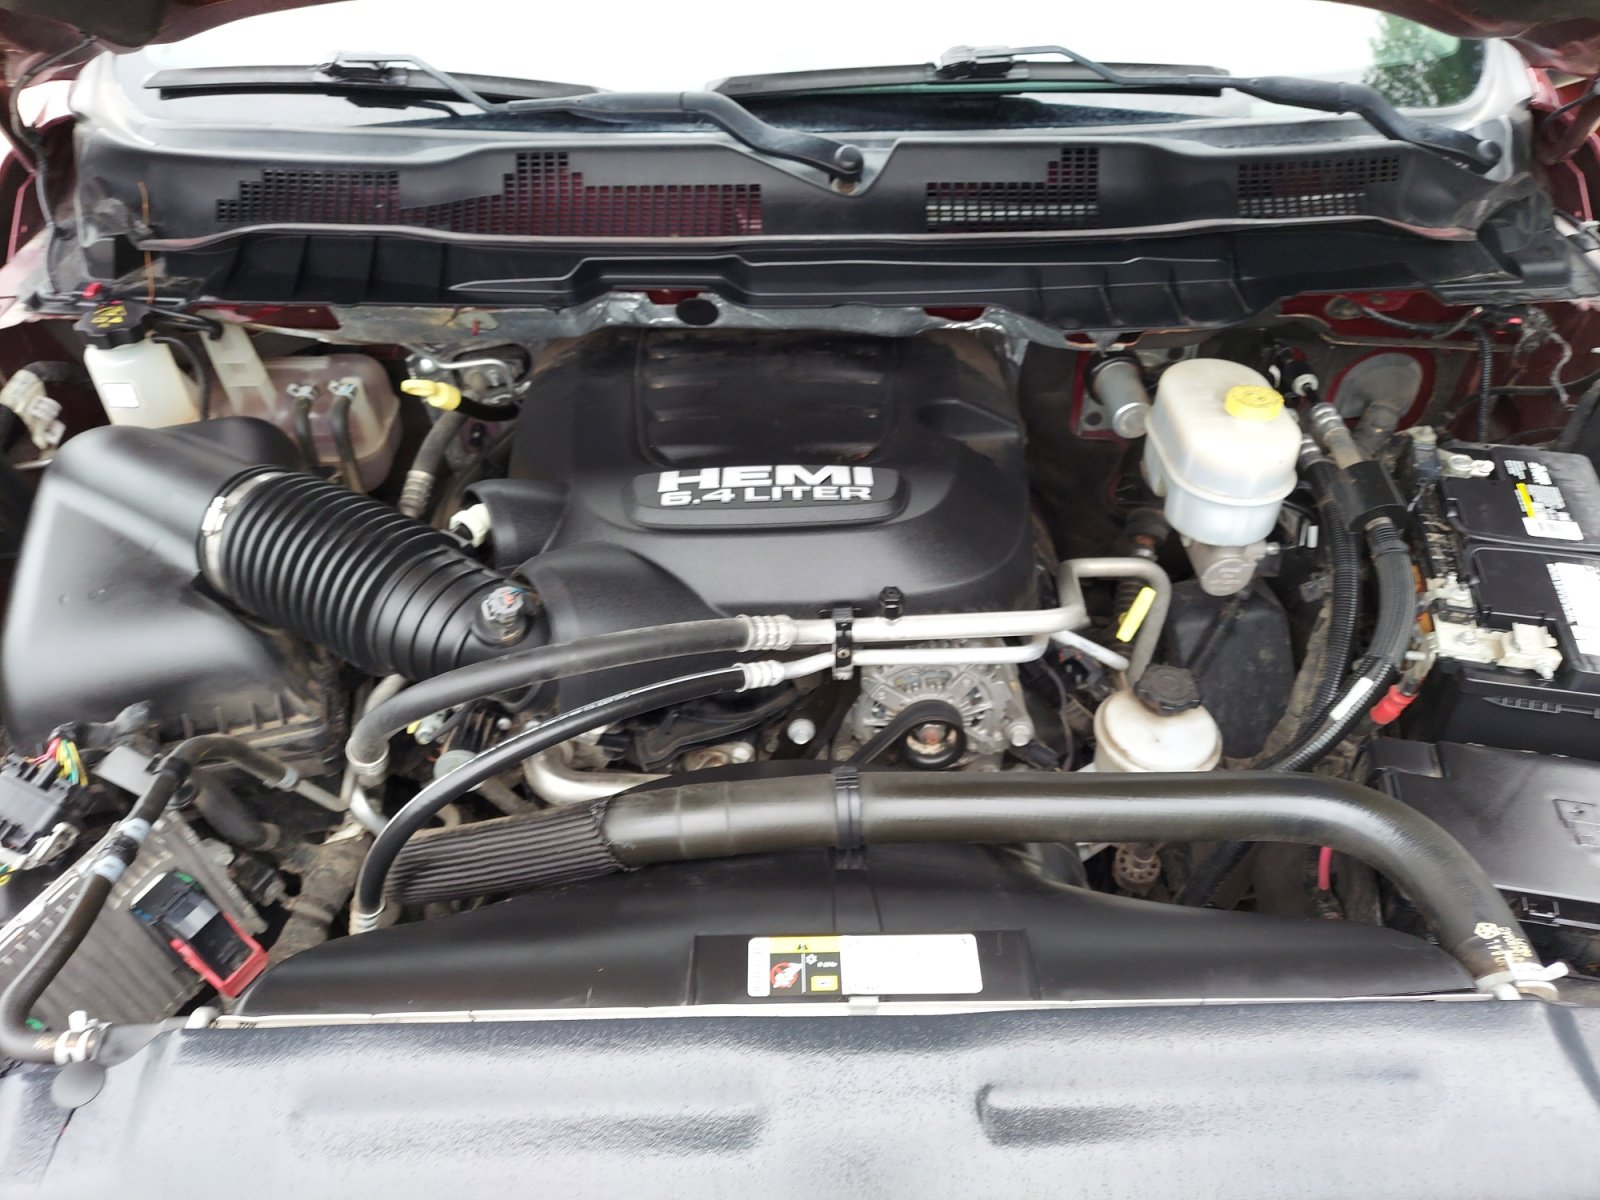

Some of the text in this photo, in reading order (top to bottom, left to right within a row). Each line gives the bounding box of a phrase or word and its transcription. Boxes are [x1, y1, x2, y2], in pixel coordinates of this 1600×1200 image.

[657, 465, 874, 492] HEMI
[660, 486, 872, 506] 6.4 LITER
